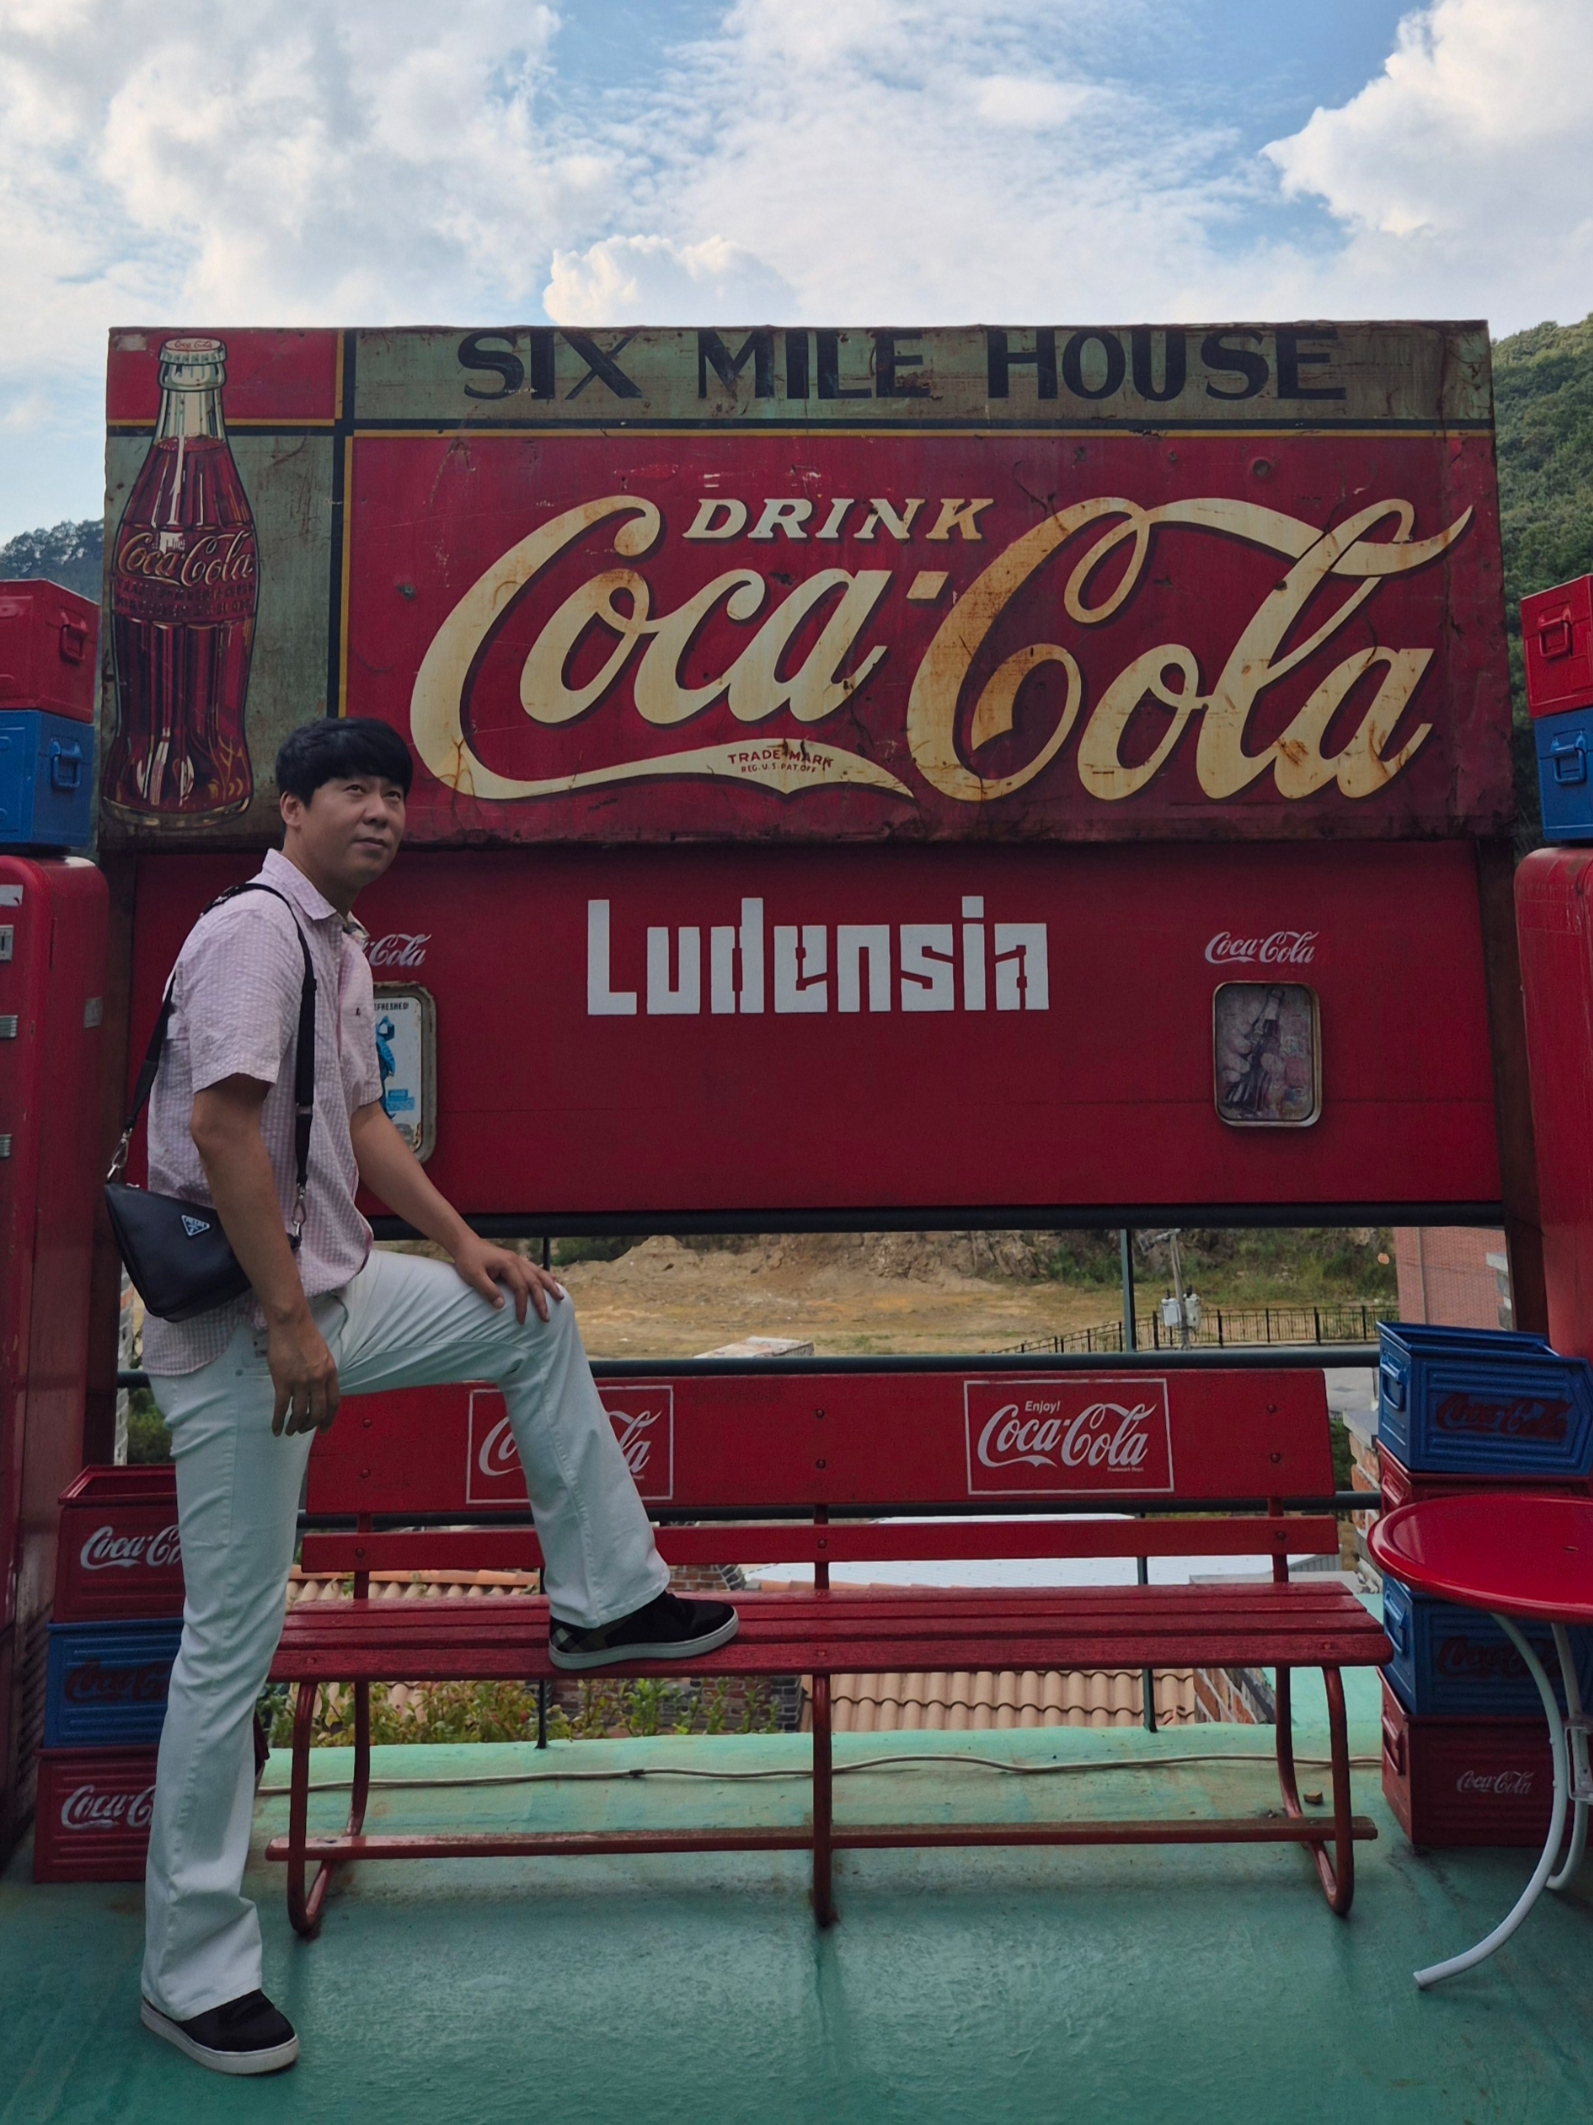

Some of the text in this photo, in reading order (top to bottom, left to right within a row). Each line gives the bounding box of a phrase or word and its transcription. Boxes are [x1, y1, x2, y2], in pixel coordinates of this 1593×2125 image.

[457, 327, 1347, 402] SIX MILE HOUSE
[682, 498, 994, 540] DRINK
[410, 495, 1473, 801] Coca-Cola
[727, 749, 781, 764] TRADE
[587, 895, 1049, 1016] Ludensia
[1205, 931, 1319, 964] Coca-Cola
[1024, 1400, 1061, 1414] Enjoy!
[977, 1403, 1157, 1468] Coca-Cola
[61, 1784, 157, 1829] Coca-C
